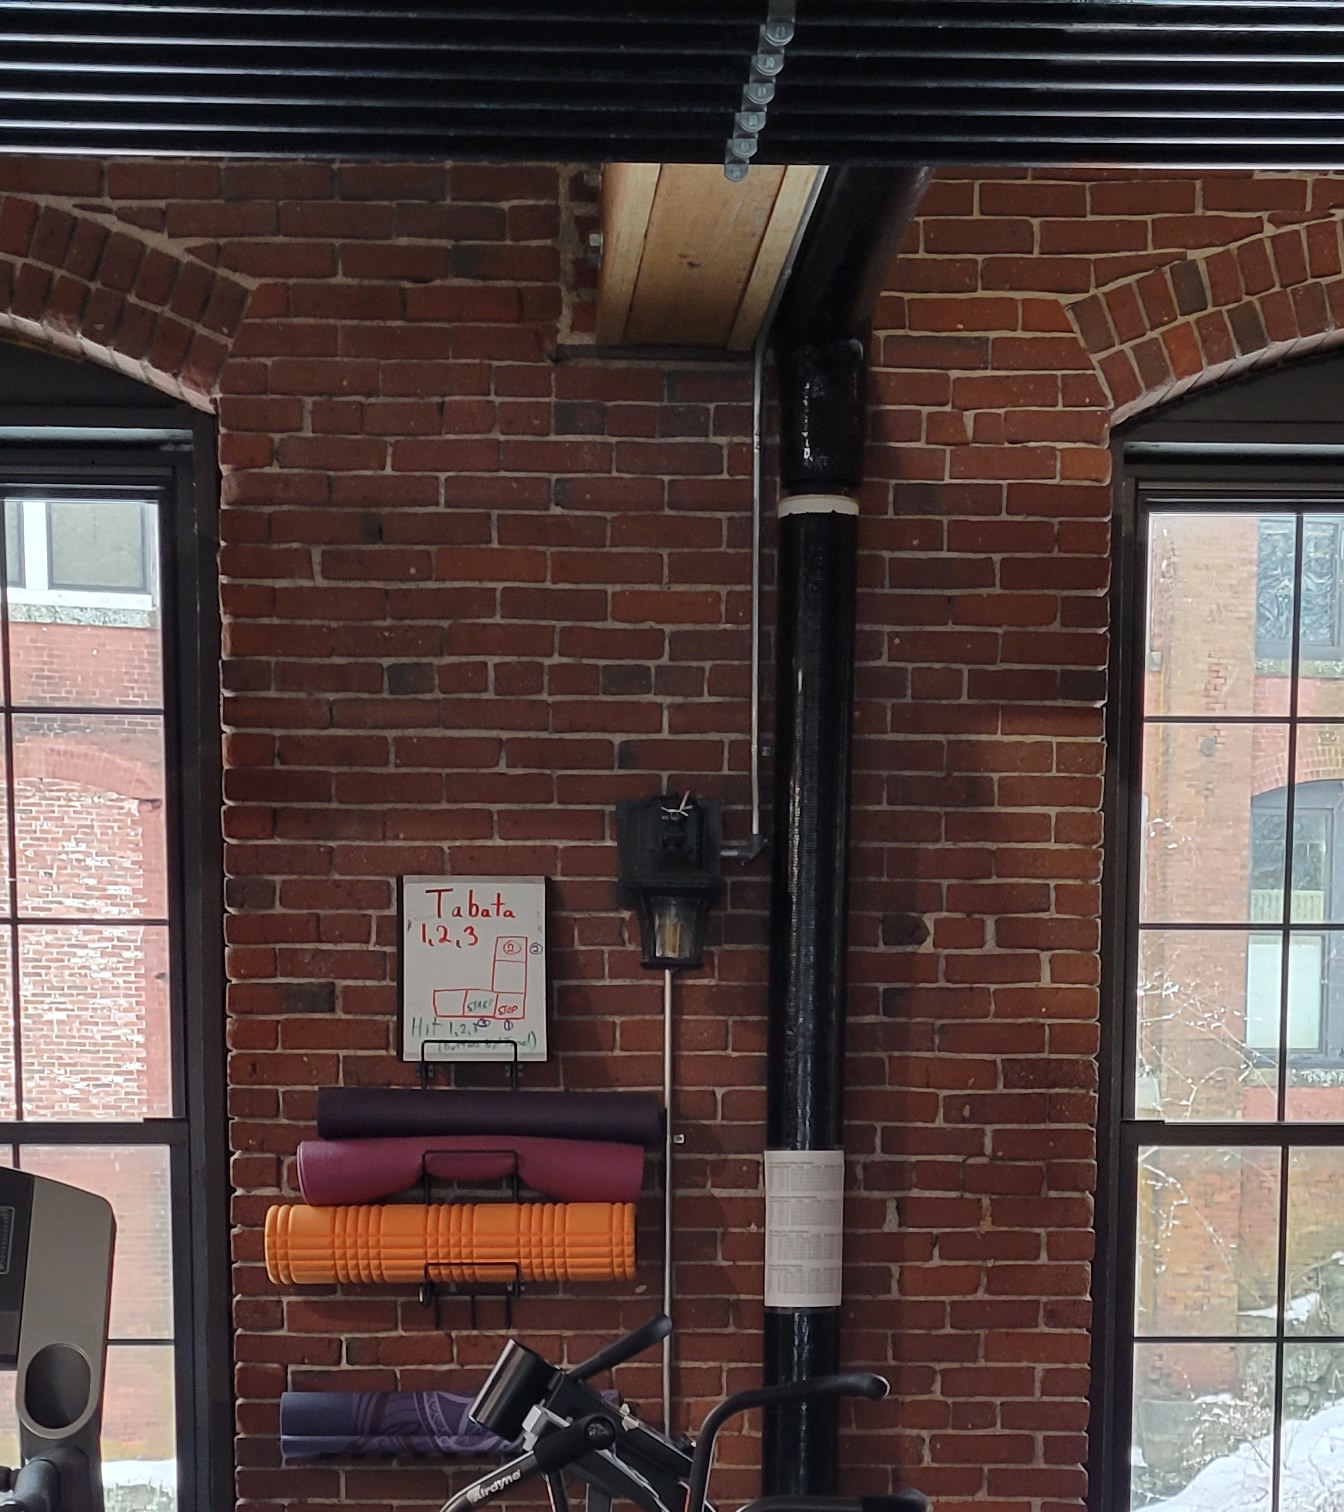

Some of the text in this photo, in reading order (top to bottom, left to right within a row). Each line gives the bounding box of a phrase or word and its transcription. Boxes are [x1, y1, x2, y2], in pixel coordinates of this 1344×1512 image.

[425, 888, 515, 919] Tabata
[467, 1000, 494, 1012] START
[498, 1006, 518, 1015] STOP
[412, 1017, 441, 1036] Hit
